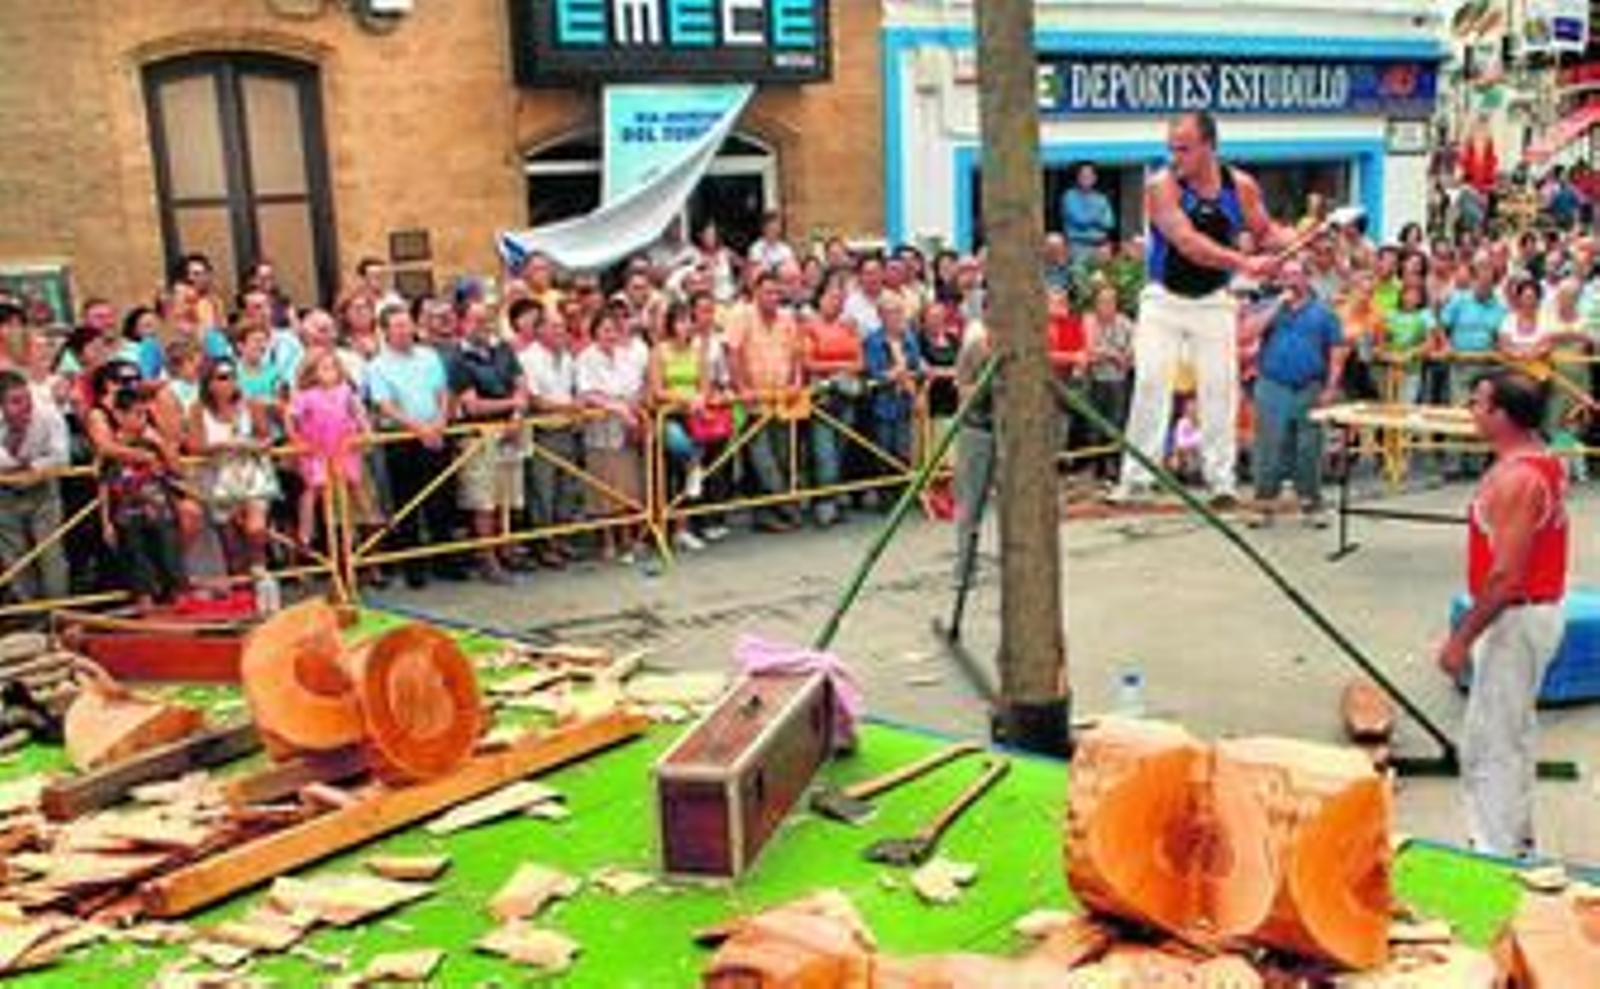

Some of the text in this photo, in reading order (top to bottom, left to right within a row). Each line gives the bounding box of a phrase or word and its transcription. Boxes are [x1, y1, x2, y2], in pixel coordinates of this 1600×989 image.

[557, 0, 815, 45] EMECE
[1071, 64, 1347, 109] DEPORTES ESTUDILLO
